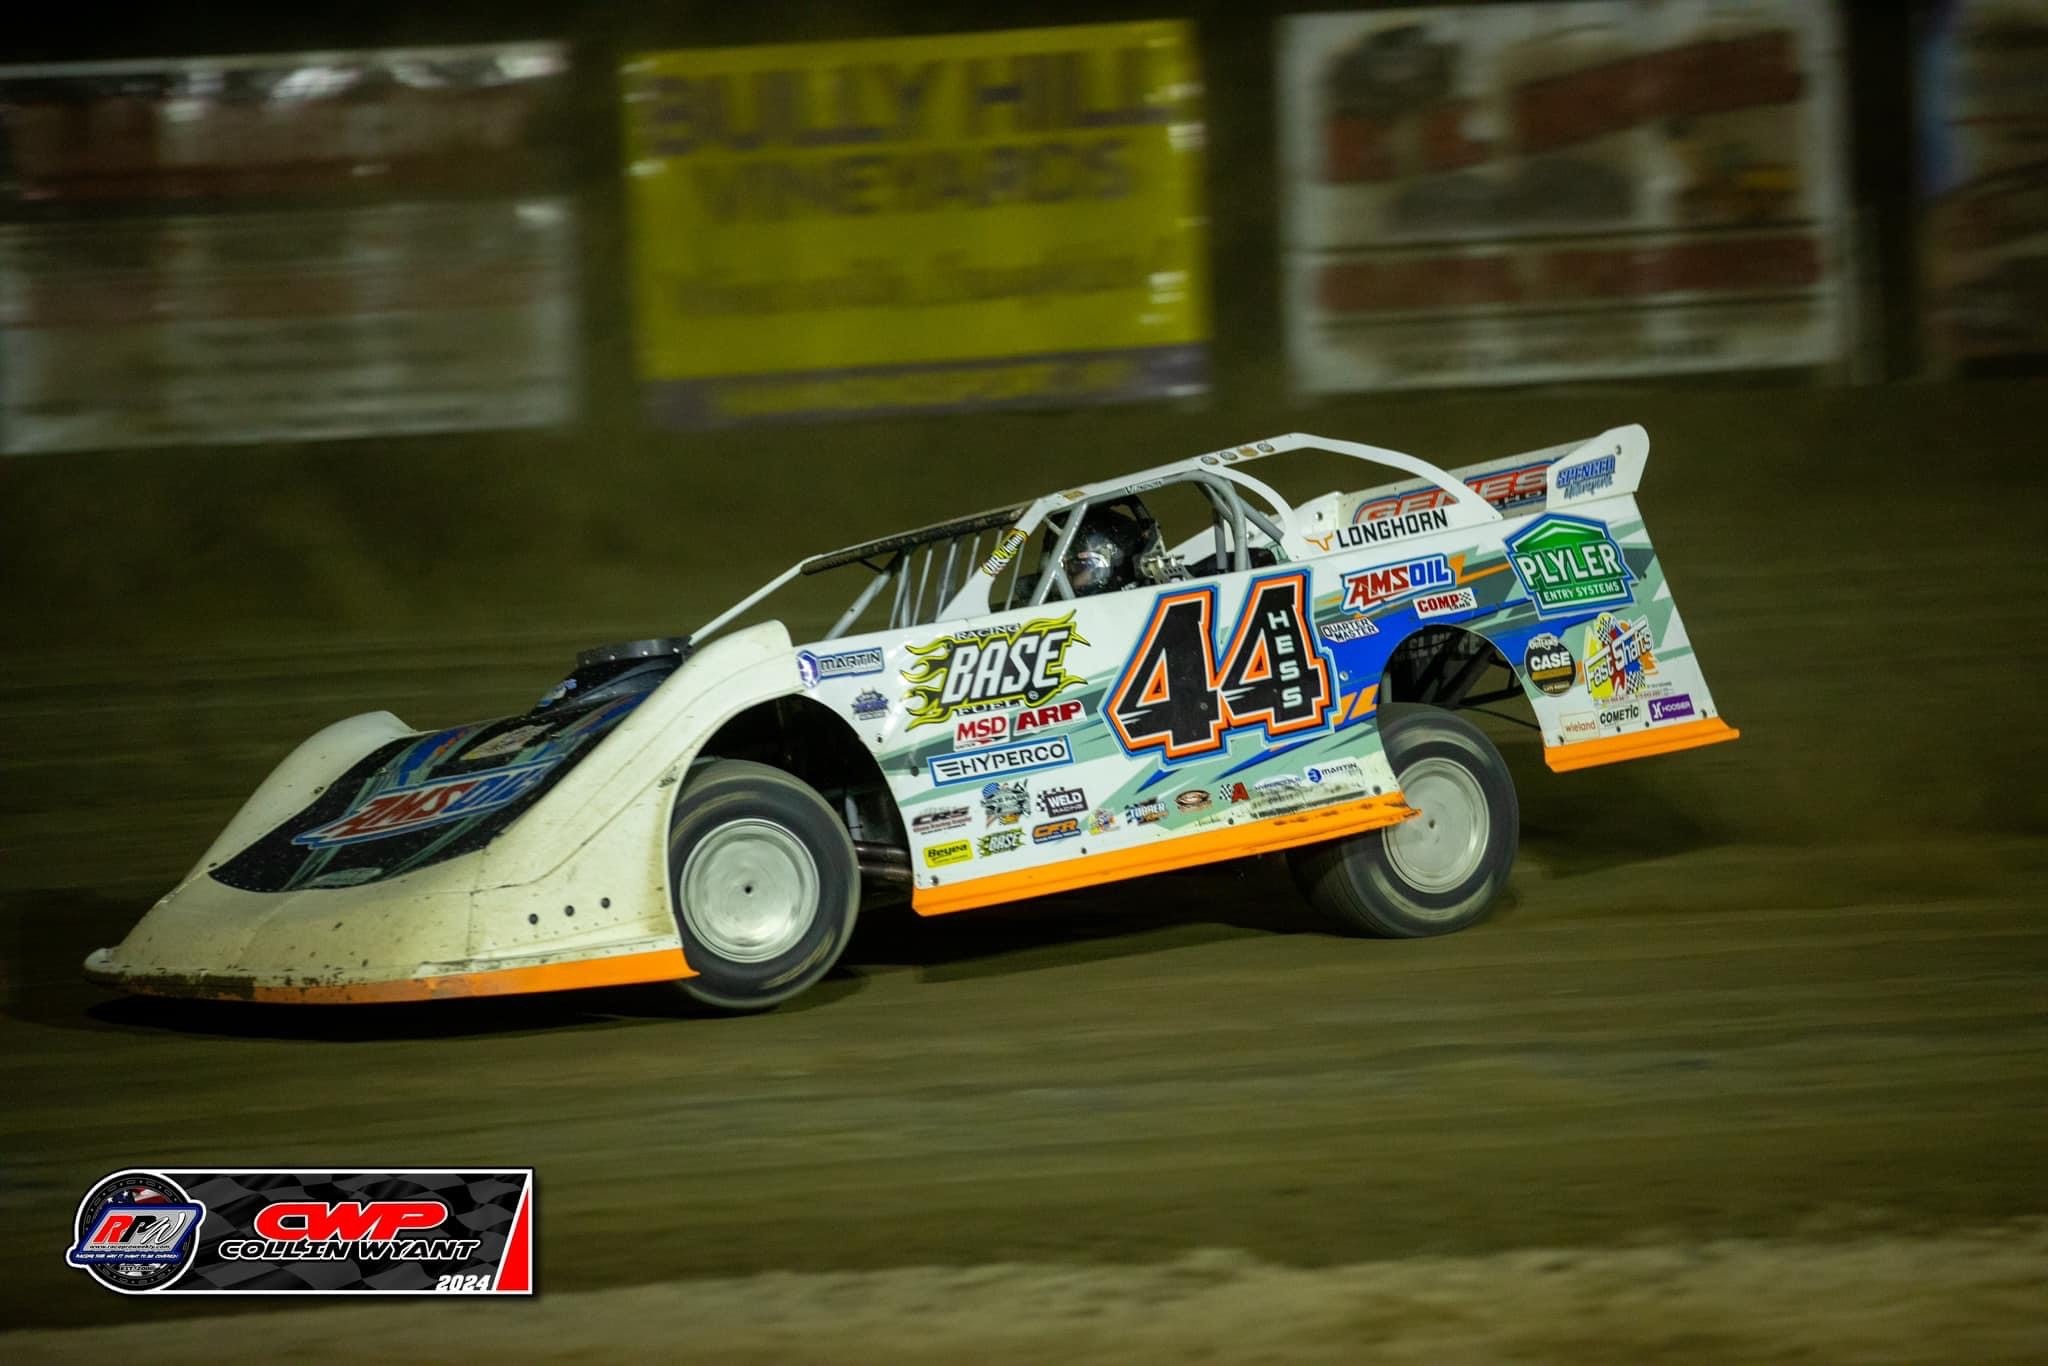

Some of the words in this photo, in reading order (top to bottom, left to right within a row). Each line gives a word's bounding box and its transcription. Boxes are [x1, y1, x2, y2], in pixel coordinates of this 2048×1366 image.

[1337, 509, 1449, 549] LONGHORN
[1516, 543, 1623, 588] PLYLER
[1346, 556, 1452, 606] AMSOIL
[1543, 587, 1575, 603] ENTRY
[1576, 580, 1621, 598] SYSTEMS
[1416, 593, 1460, 613] COMP
[1322, 618, 1370, 637] QUARTER
[1334, 625, 1376, 642] MASTER
[820, 650, 882, 672] MARTIN
[941, 630, 1069, 704] BASE
[1107, 576, 1330, 757] 44
[1267, 609, 1304, 709] HESS
[1531, 651, 1571, 671] CASE
[1016, 701, 1082, 731] ARP
[1661, 700, 1692, 714] HOOSIER
[957, 715, 1007, 742] MSD
[960, 742, 1066, 776] HYPERCO
[1047, 791, 1083, 809] WELD
